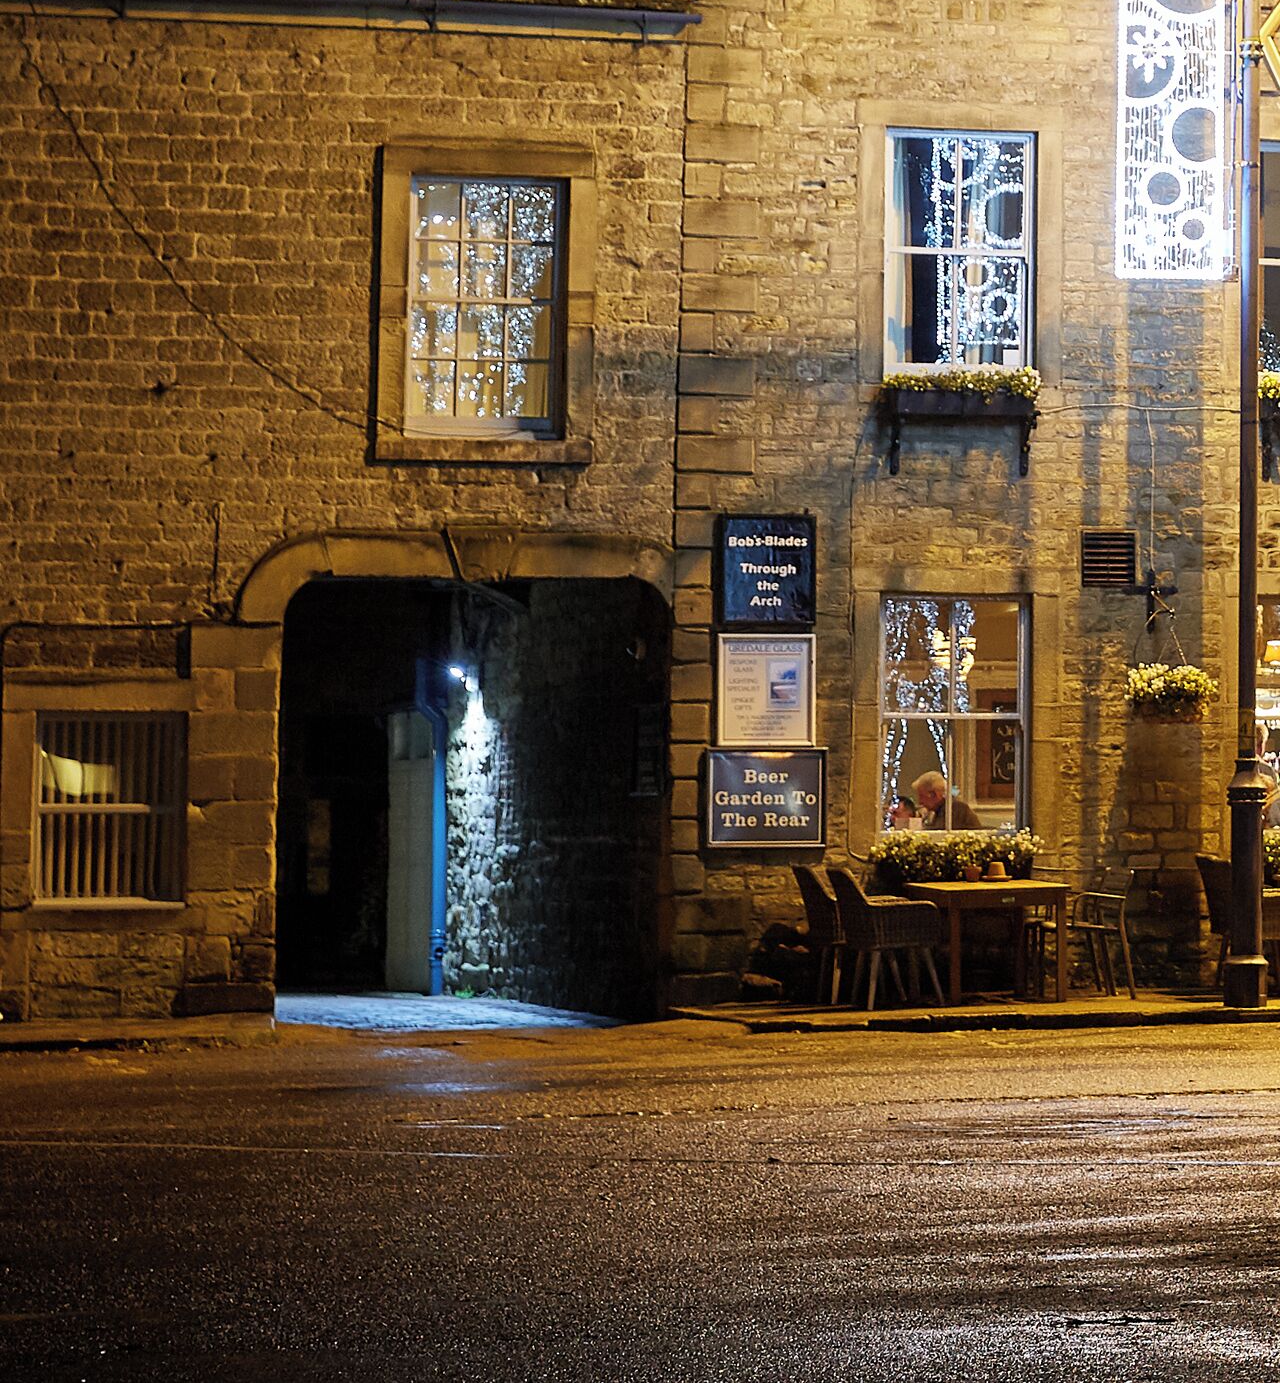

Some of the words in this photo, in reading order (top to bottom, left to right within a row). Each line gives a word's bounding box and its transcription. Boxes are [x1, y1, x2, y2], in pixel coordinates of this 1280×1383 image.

[740, 562, 797, 577] Through
[756, 580, 780, 591] the
[749, 595, 782, 606] Arch
[743, 769, 789, 784] Beer
[714, 790, 786, 806] Garden
[791, 790, 817, 806] To
[720, 812, 758, 827] The
[763, 812, 810, 827] Rear
